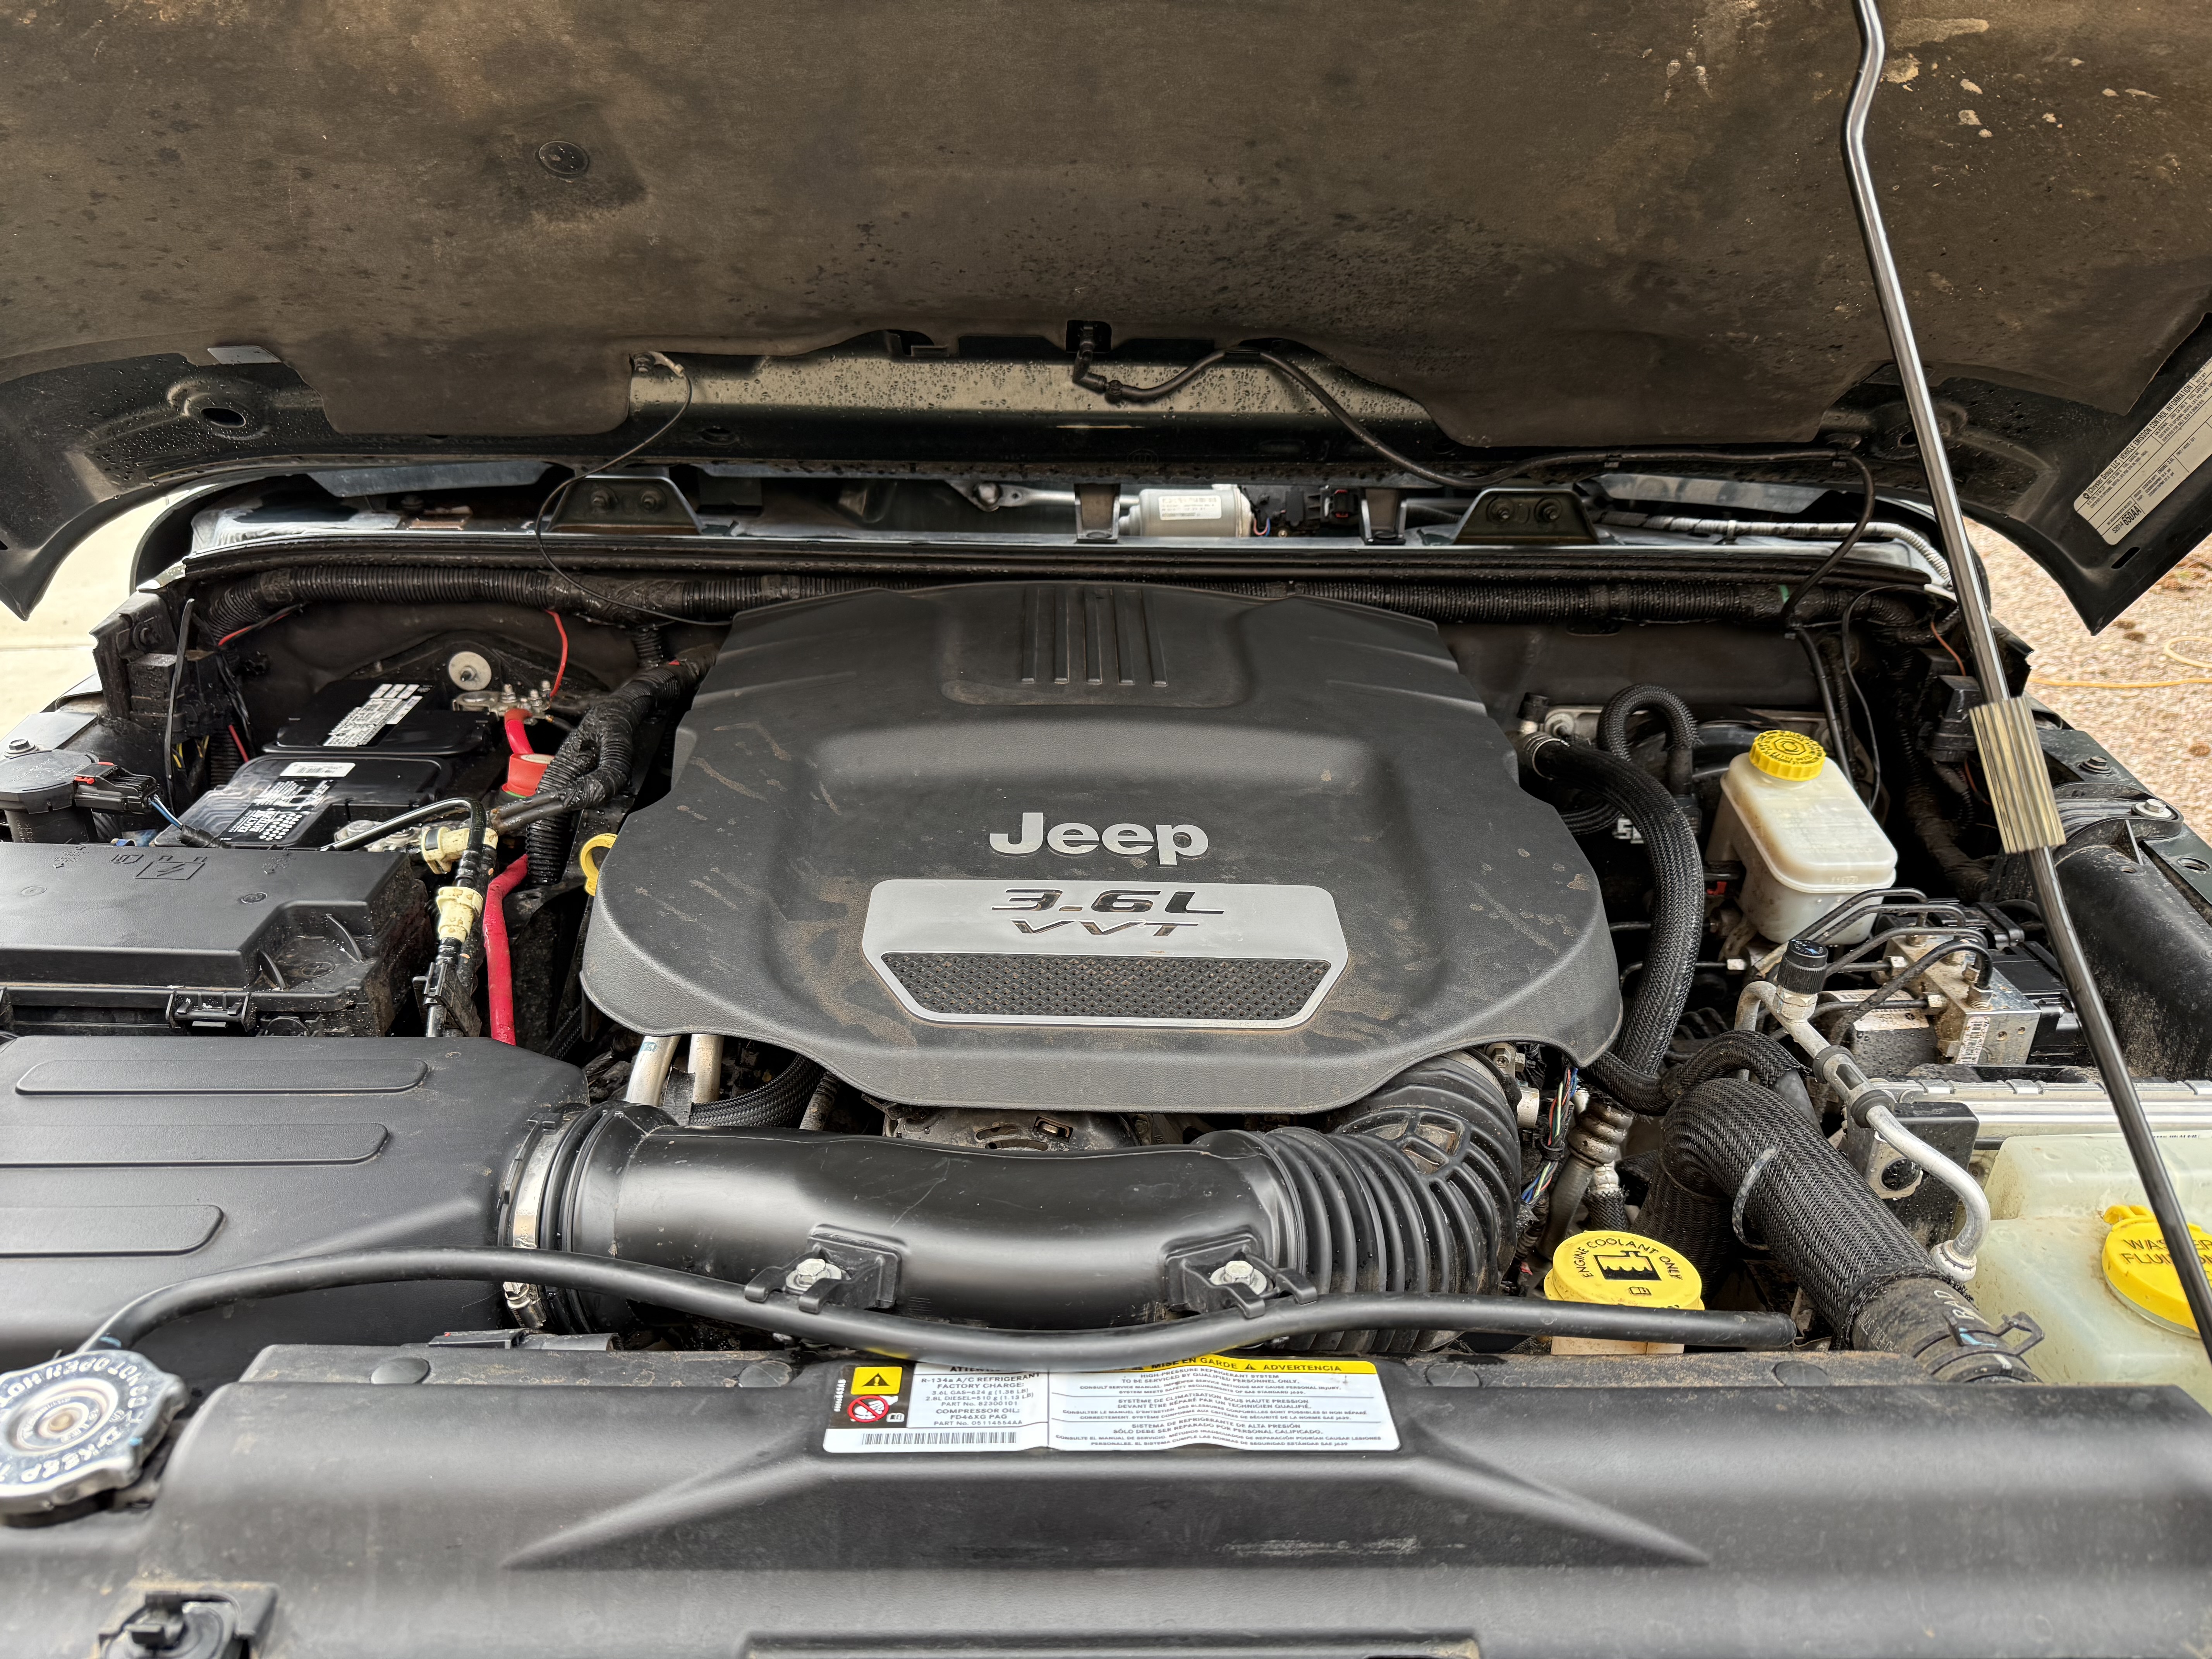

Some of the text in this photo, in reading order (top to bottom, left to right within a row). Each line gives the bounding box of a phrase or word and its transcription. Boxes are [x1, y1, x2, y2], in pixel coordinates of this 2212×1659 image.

[2119, 385, 2193, 460] VEHICLE EMISSION CONTROL INFORMATION
[2088, 460, 2120, 493] Chrysler Group LLC
[2122, 506, 2142, 526] 650AA
[989, 812, 1209, 867] Jeep
[992, 888, 1224, 914] 3.6L
[1011, 919, 1199, 936] VVT
[2122, 1239, 2212, 1250] WASER
[1574, 1238, 1683, 1280] ENGINE COOLANT ONLY
[2120, 1253, 2171, 1264] FLUI
[46, 1357, 111, 1379] OPEN
[1140, 1368, 1198, 1378] HIGH-PRESSURE
[1200, 1367, 1249, 1378] REFRIGERANT
[1200, 1358, 1238, 1369] GARDE
[108, 1361, 143, 1387] NOT
[977, 1373, 1040, 1382] REFRIGERANT
[1145, 1375, 1180, 1383] SERVICED
[1193, 1372, 1231, 1382] QUALIFIED
[1166, 1392, 1221, 1401] CLIMATISATION
